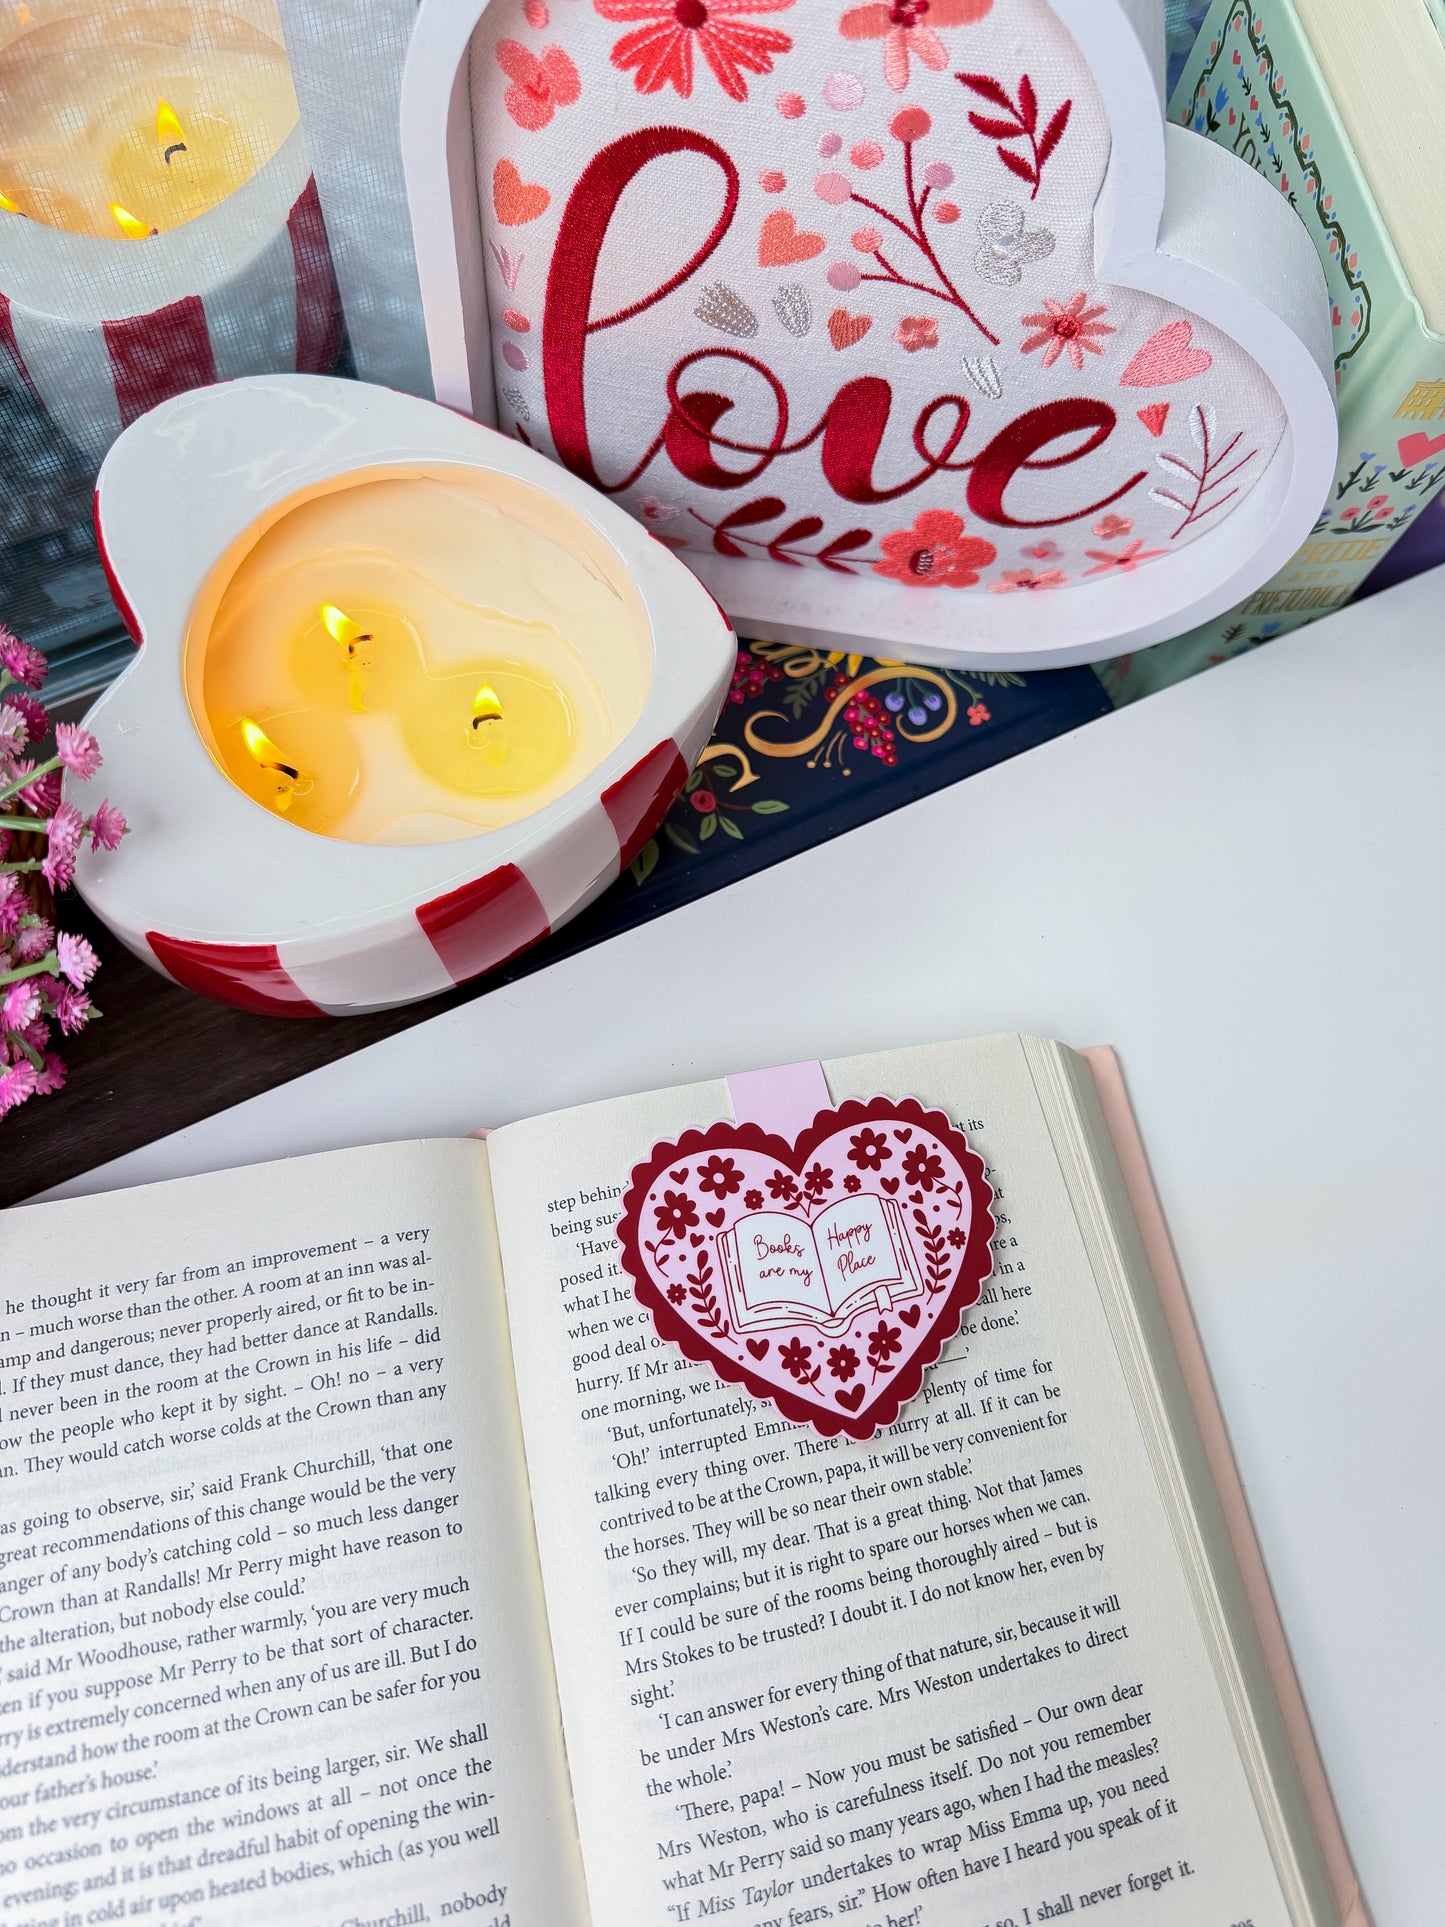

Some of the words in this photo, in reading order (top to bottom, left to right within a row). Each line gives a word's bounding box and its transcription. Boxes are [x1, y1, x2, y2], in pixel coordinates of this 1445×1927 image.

[1232, 112, 1267, 178] YO
[5, 1299, 24, 1314] he
[31, 1287, 92, 1310] thought
[98, 1284, 109, 1298] it
[115, 1278, 149, 1294] very
[155, 1271, 176, 1287] far
[182, 1265, 220, 1282] from
[226, 1260, 245, 1273] an
[252, 1237, 357, 1269] improvement
[380, 1234, 389, 1245] a
[395, 1228, 430, 1243] very
[754, 1233, 805, 1260] Books
[827, 1222, 872, 1250] Happy
[837, 1250, 876, 1281] Place
[559, 1263, 604, 1292] posed
[607, 1262, 624, 1276] it.
[760, 1266, 785, 1278] are
[789, 1267, 813, 1286] my
[1000, 1285, 1032, 1300] here
[12, 1375, 26, 1393] If
[30, 1373, 65, 1390] they
[70, 1363, 109, 1382] must
[114, 1356, 164, 1374] dance,
[168, 1347, 203, 1363] they
[207, 1336, 237, 1356] had
[241, 1331, 288, 1349] better
[293, 1321, 339, 1339] dance
[344, 1316, 360, 1330] at
[364, 1302, 437, 1326] Randalls.
[36, 1342, 65, 1361] and
[70, 1331, 154, 1355] dangerous;
[159, 1321, 202, 1339] never
[206, 1304, 272, 1334] properly
[276, 1294, 320, 1316] aired,
[325, 1294, 342, 1307] or
[346, 1286, 364, 1303] fit
[367, 1286, 384, 1299] to
[388, 1280, 407, 1295] be
[412, 1278, 434, 1292] in-
[575, 1373, 622, 1393] hurry.
[626, 1363, 640, 1381] If
[643, 1359, 668, 1377] Mr
[934, 1410, 949, 1424] at
[954, 1402, 975, 1420] all.
[979, 1396, 992, 1414] If
[997, 1396, 1009, 1410] it
[1013, 1392, 1039, 1406] can
[1042, 1384, 1060, 1399] be
[23, 1455, 64, 1472] They
[68, 1440, 118, 1464] would
[123, 1432, 165, 1454] catch
[169, 1427, 216, 1445] worse
[220, 1414, 261, 1435] colds
[266, 1412, 281, 1427] at
[285, 1406, 311, 1423] the
[316, 1398, 372, 1417] Crown
[376, 1389, 414, 1406] than
[418, 1384, 446, 1400] any
[42, 1516, 189, 1555] recommendations
[194, 1506, 211, 1526] of
[214, 1503, 244, 1522] this
[249, 1494, 305, 1515] change
[309, 1478, 361, 1503] would
[365, 1477, 385, 1493] be
[389, 1471, 416, 1488] the
[420, 1466, 456, 1483] very
[604, 1542, 629, 1560] the
[632, 1532, 689, 1553] horses.
[692, 1520, 731, 1539] They
[735, 1508, 766, 1529] will
[767, 1505, 788, 1521] be
[792, 1502, 809, 1516] so
[812, 1493, 846, 1511] near
[850, 1481, 886, 1502] their
[890, 1475, 923, 1492] own
[0, 1602, 54, 1622] Crown
[60, 1592, 98, 1610] than
[104, 1587, 118, 1602] at
[124, 1568, 200, 1598] Randalls!
[206, 1563, 232, 1582] Mr
[237, 1557, 282, 1576] Perry
[288, 1543, 337, 1567] might
[342, 1538, 380, 1556] have
[386, 1527, 441, 1547] reason
[445, 1522, 462, 1535] to
[614, 1600, 647, 1617] ever
[653, 1579, 740, 1608] complains;
[742, 1569, 770, 1587] but
[774, 1565, 786, 1580] it
[789, 1561, 803, 1576] is
[806, 1550, 845, 1573] right
[847, 1548, 864, 1561] to
[868, 1537, 909, 1560] spare
[912, 1529, 938, 1545] our
[941, 1516, 990, 1538] horses
[992, 1505, 1034, 1524] when
[1036, 1499, 1057, 1513] we
[1060, 1492, 1090, 1507] can.
[30, 1620, 114, 1646] alteration,
[119, 1611, 146, 1629] but
[151, 1596, 214, 1623] nobody
[219, 1591, 249, 1609] else
[624, 1657, 658, 1676] Mrs
[661, 1644, 714, 1667] Stokes
[717, 1640, 734, 1654] to
[737, 1632, 758, 1649] be
[762, 1613, 824, 1643] trusted?
[829, 1610, 838, 1626] I
[841, 1599, 888, 1623] doubt
[890, 1595, 906, 1610] it.
[909, 1589, 918, 1605] I
[921, 1585, 941, 1602] do
[944, 1578, 971, 1596] not
[972, 1568, 1014, 1588] know
[1017, 1560, 1047, 1576] her,
[1050, 1550, 1084, 1568] even
[1086, 1544, 1104, 1561] by
[29, 1817, 56, 1836] the
[62, 1810, 100, 1827] very
[105, 1786, 220, 1820] circumstance
[225, 1774, 244, 1795] of
[248, 1774, 268, 1791] its
[272, 1765, 321, 1786] being
[325, 1753, 379, 1775] larger,
[385, 1744, 410, 1762] sir.
[414, 1735, 443, 1755] We
[449, 1725, 488, 1748] shall
[675, 1799, 734, 1820] ‘There,
[738, 1779, 784, 1810] papa!
[805, 1768, 845, 1789] Now
[850, 1758, 882, 1781] you
[886, 1743, 927, 1767] must
[929, 1737, 950, 1754] be
[955, 1714, 1018, 1748] satisfied
[1037, 1704, 1068, 1723] Our
[1073, 1694, 1107, 1713] own
[1111, 1683, 1143, 1702] dear
[1021, 1907, 1031, 1925] I
[1036, 1893, 1074, 1921] shall
[1078, 1883, 1122, 1908] never
[1126, 1865, 1174, 1892] forget
[1178, 1860, 1194, 1876] it.
